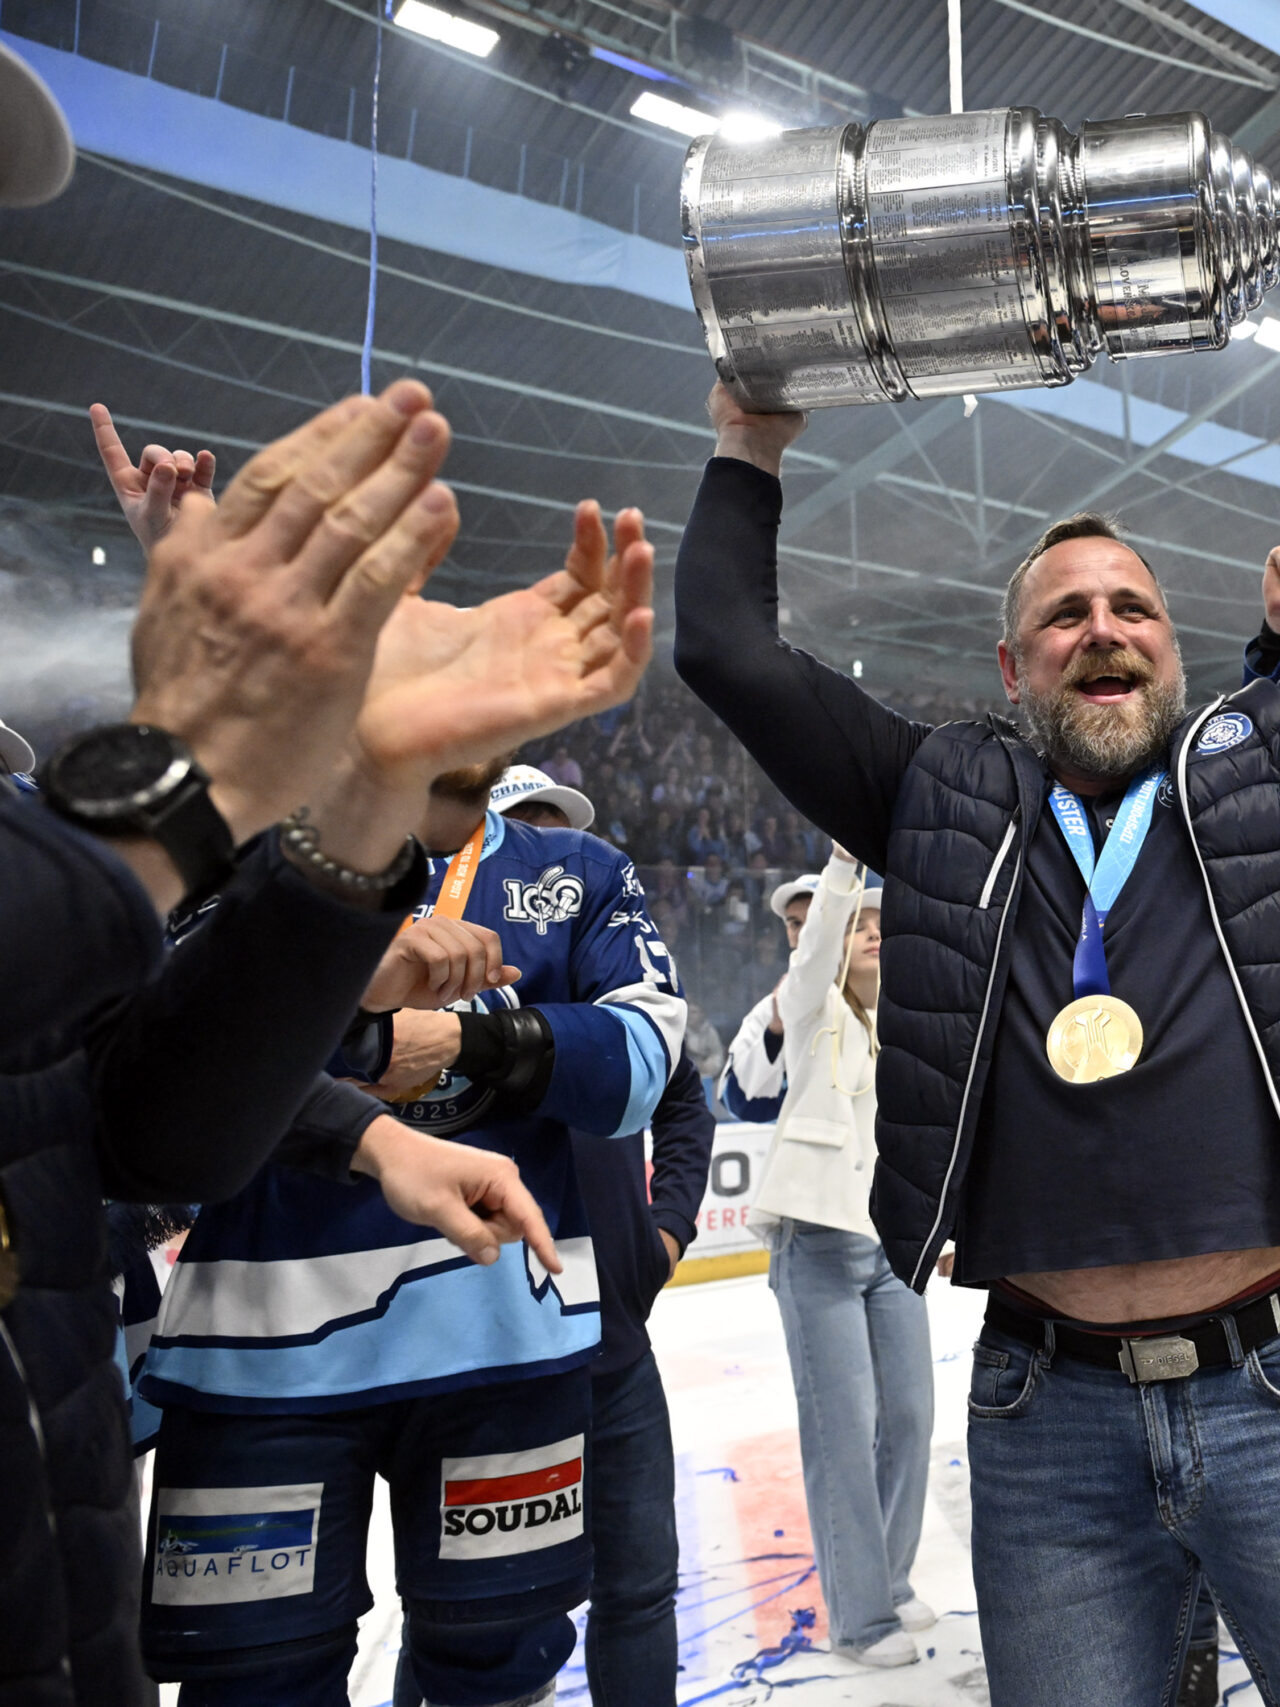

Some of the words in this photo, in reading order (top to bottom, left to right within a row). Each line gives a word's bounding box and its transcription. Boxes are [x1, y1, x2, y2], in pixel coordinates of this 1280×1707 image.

[1120, 797, 1147, 845] TIPSPORT
[1141, 780, 1156, 801] LIGA
[400, 1100, 458, 1119] 1925
[1157, 1353, 1190, 1365] DIESEL
[443, 1487, 582, 1537] SOUDAL
[155, 1547, 312, 1578] AQUAFLOT
